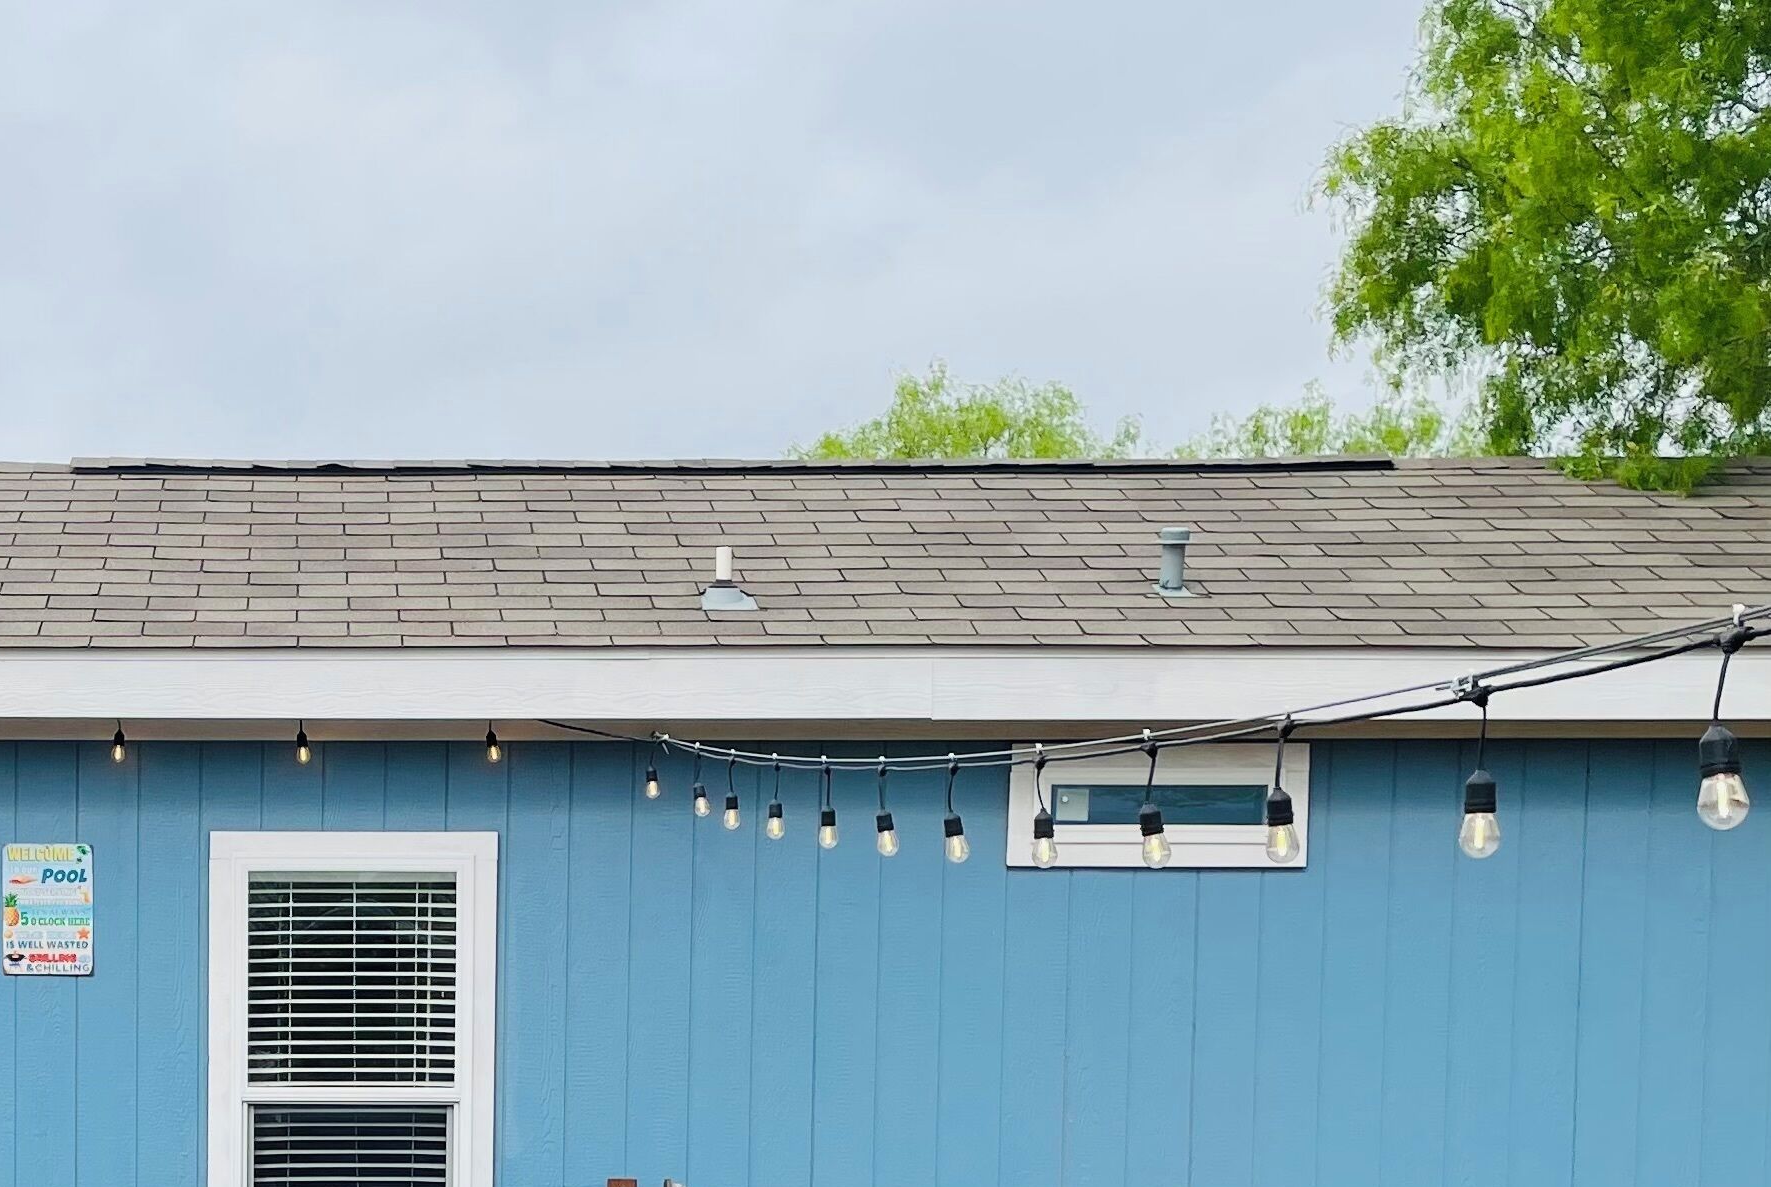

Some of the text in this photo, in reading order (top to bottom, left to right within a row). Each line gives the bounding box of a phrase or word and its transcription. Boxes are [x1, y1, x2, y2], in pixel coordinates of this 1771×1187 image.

[8, 847, 74, 862] WELCOME
[41, 868, 88, 883] POOL
[20, 912, 29, 926] 5
[68, 917, 90, 926] HERE
[6, 941, 89, 949] IS WELL WASTED
